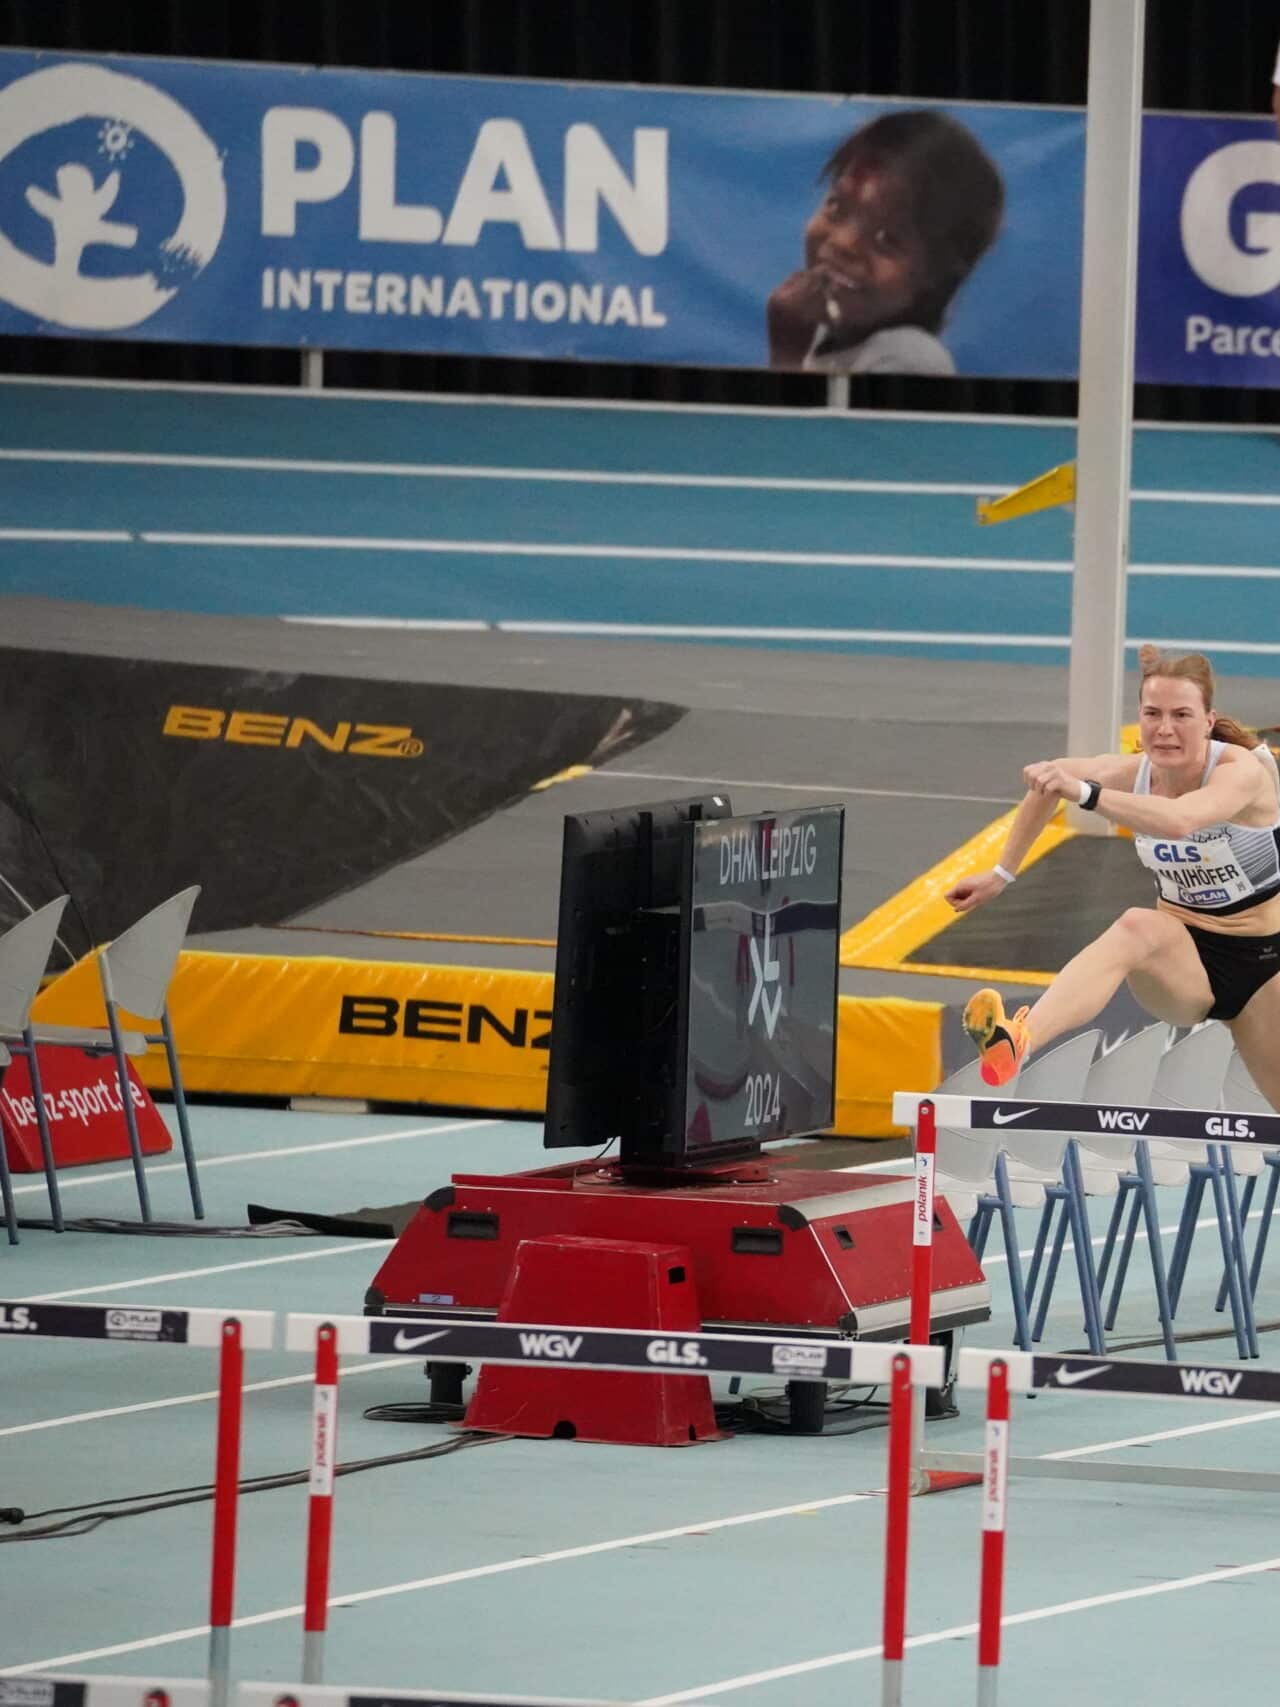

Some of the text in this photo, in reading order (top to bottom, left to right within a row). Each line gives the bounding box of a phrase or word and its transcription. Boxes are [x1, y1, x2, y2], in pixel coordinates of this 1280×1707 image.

[261, 105, 669, 257] PLAN
[261, 267, 668, 328] INTERNATIONAL
[719, 823, 817, 886] DHM LEIPZIG
[1195, 890, 1227, 903] PLAN
[744, 1071, 781, 1127] 2024
[1097, 1110, 1150, 1131] WGV
[1205, 1116, 1256, 1138] GLS.
[917, 1175, 929, 1223] polanik
[519, 1332, 583, 1359] WGV
[646, 1340, 708, 1366] GLS.
[1180, 1368, 1243, 1396] WGV
